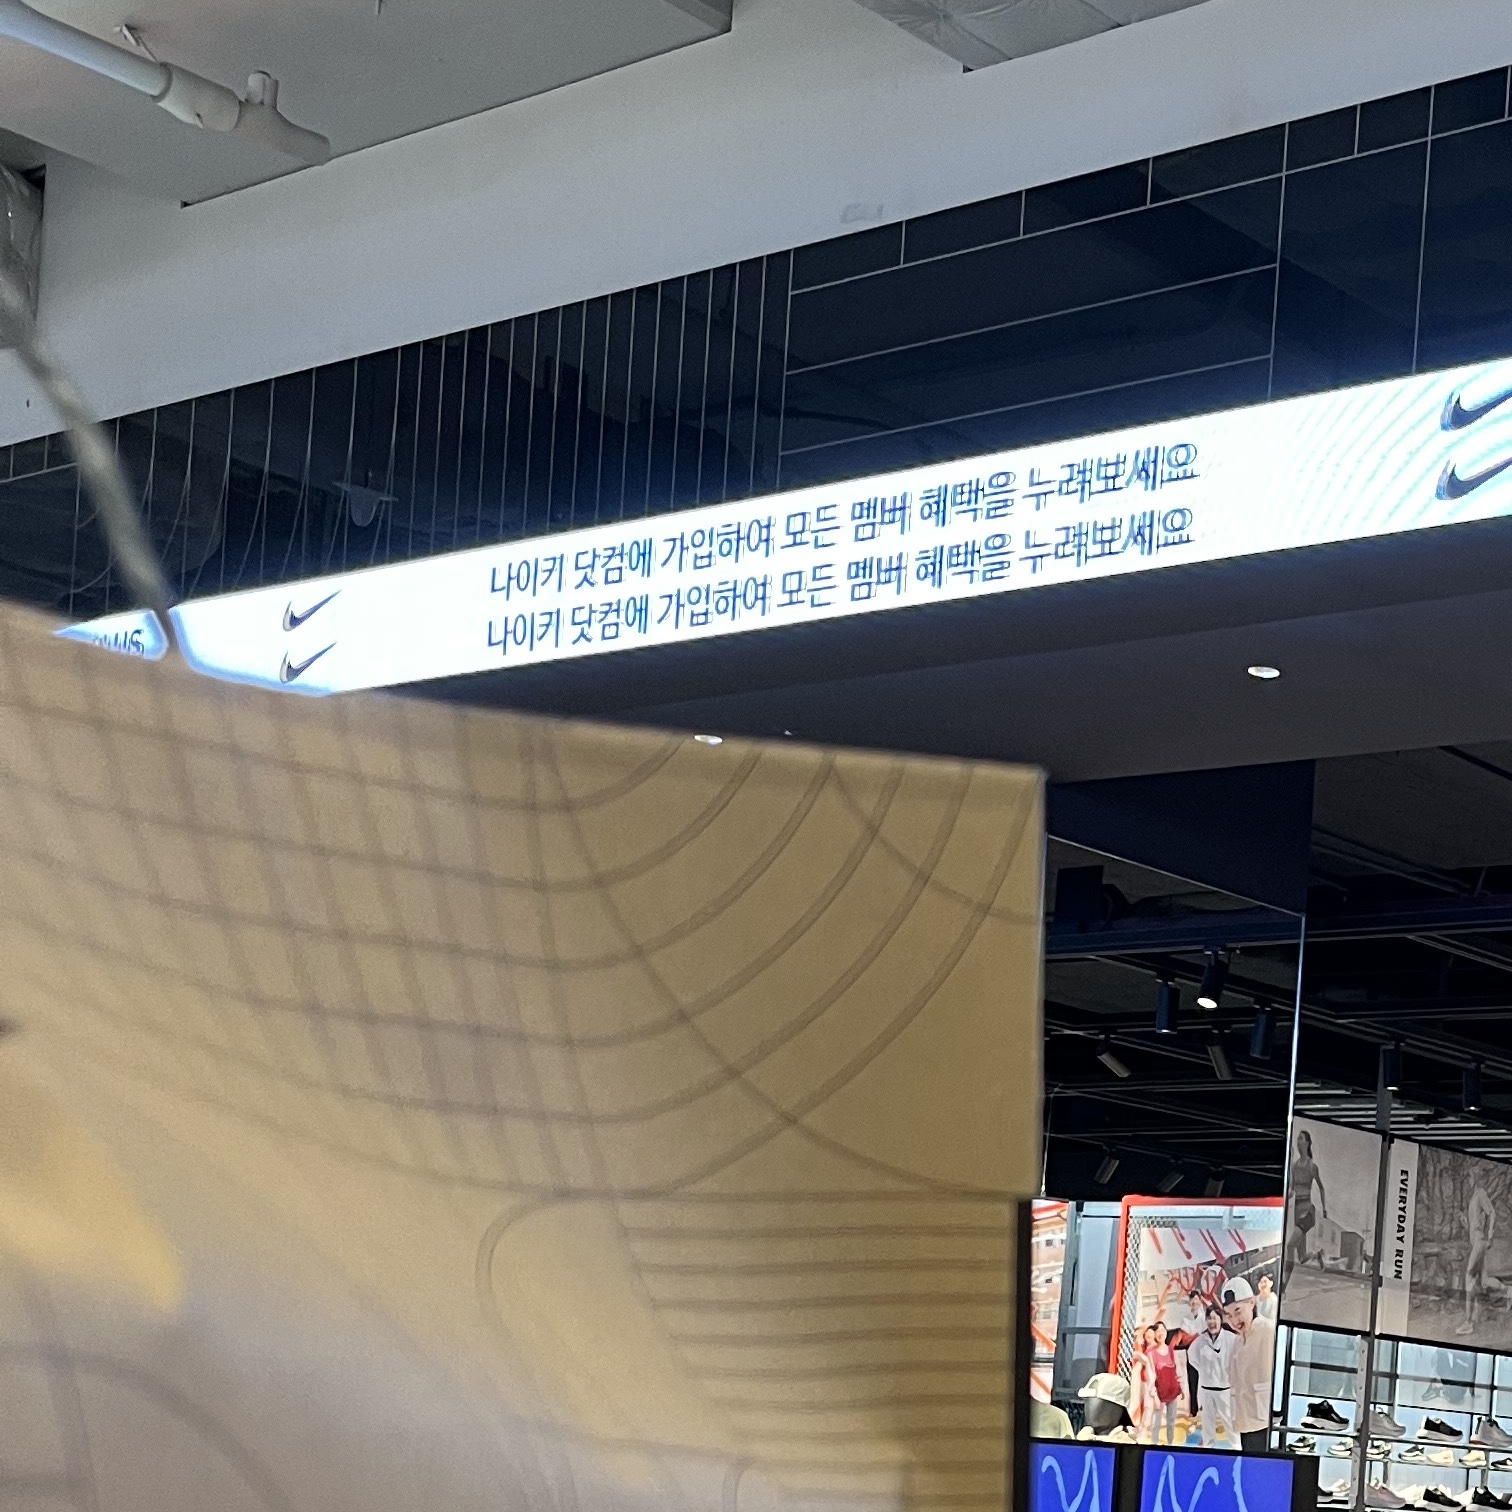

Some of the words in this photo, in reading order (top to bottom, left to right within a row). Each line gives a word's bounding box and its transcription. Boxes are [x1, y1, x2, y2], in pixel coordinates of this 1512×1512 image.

[490, 550, 566, 602] 나이키
[574, 537, 653, 591] 닷컴에
[663, 516, 776, 573] 가입하여
[780, 503, 842, 550] 모든
[850, 494, 912, 543] 멤버
[918, 470, 1018, 528] 혜택을
[487, 604, 564, 656] 나이키
[570, 592, 650, 645] 닷컴에
[657, 573, 772, 629] 가입하여
[776, 562, 838, 609] 모든
[845, 552, 907, 600] 멤버
[914, 532, 1012, 589] 혜택을
[1396, 1168, 1409, 1244] EVERYDAY
[1393, 1248, 1404, 1280] RUN
